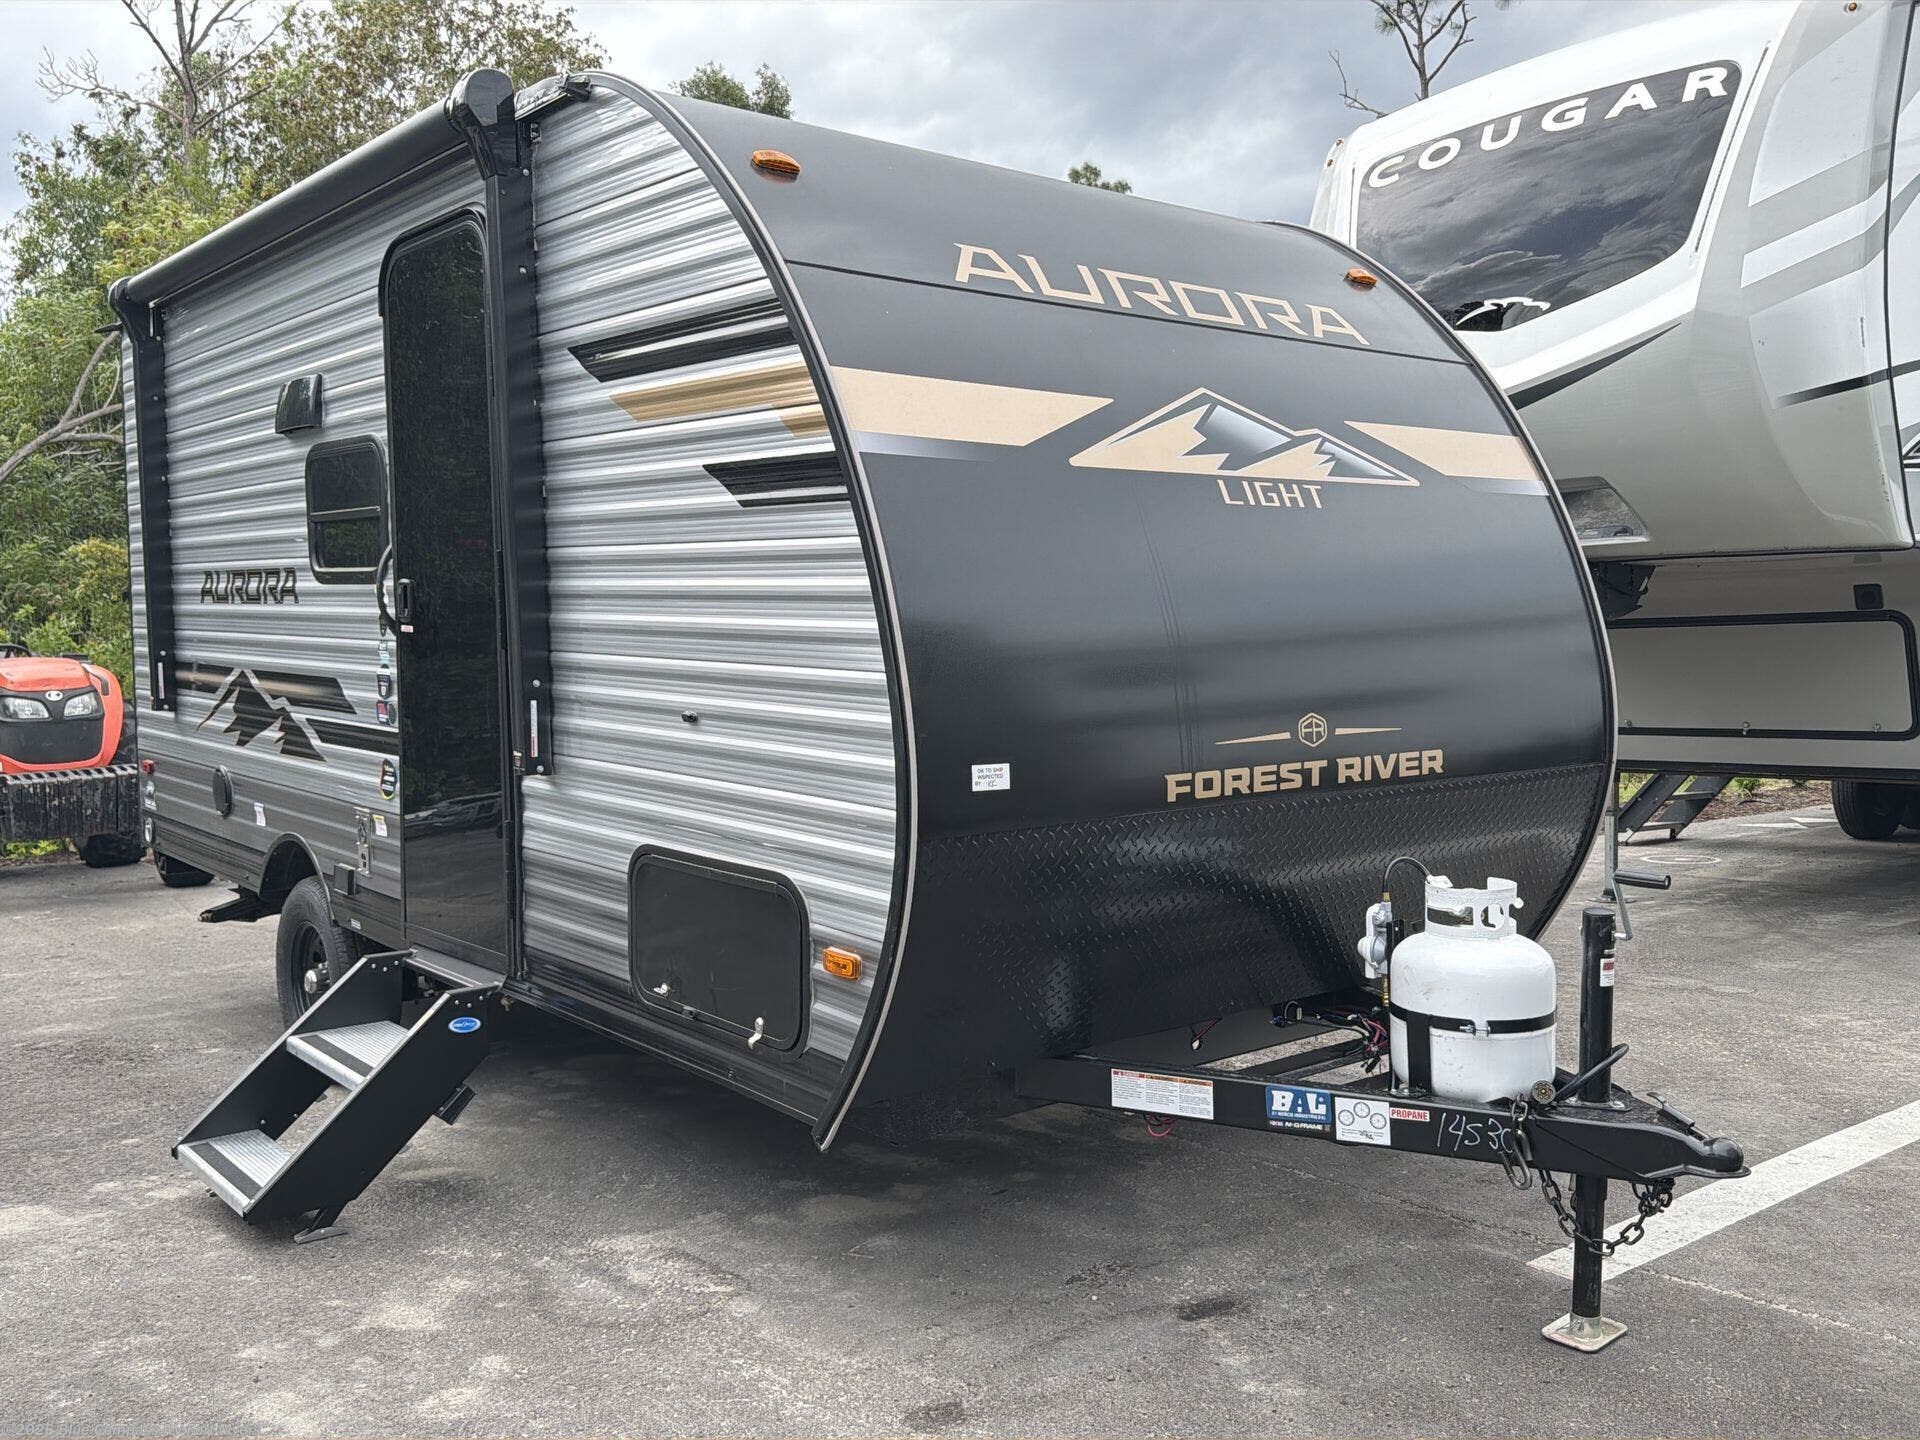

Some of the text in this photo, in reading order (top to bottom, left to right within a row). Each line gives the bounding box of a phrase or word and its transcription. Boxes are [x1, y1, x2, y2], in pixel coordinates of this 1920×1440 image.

[1368, 66, 1728, 188] COUGAR
[953, 242, 1370, 347] AURORA
[1217, 479, 1322, 509] LIGHT
[200, 567, 300, 605] AURORA
[1163, 748, 1444, 803] FOREST RIVER
[1391, 1108, 1428, 1121] PROPANE
